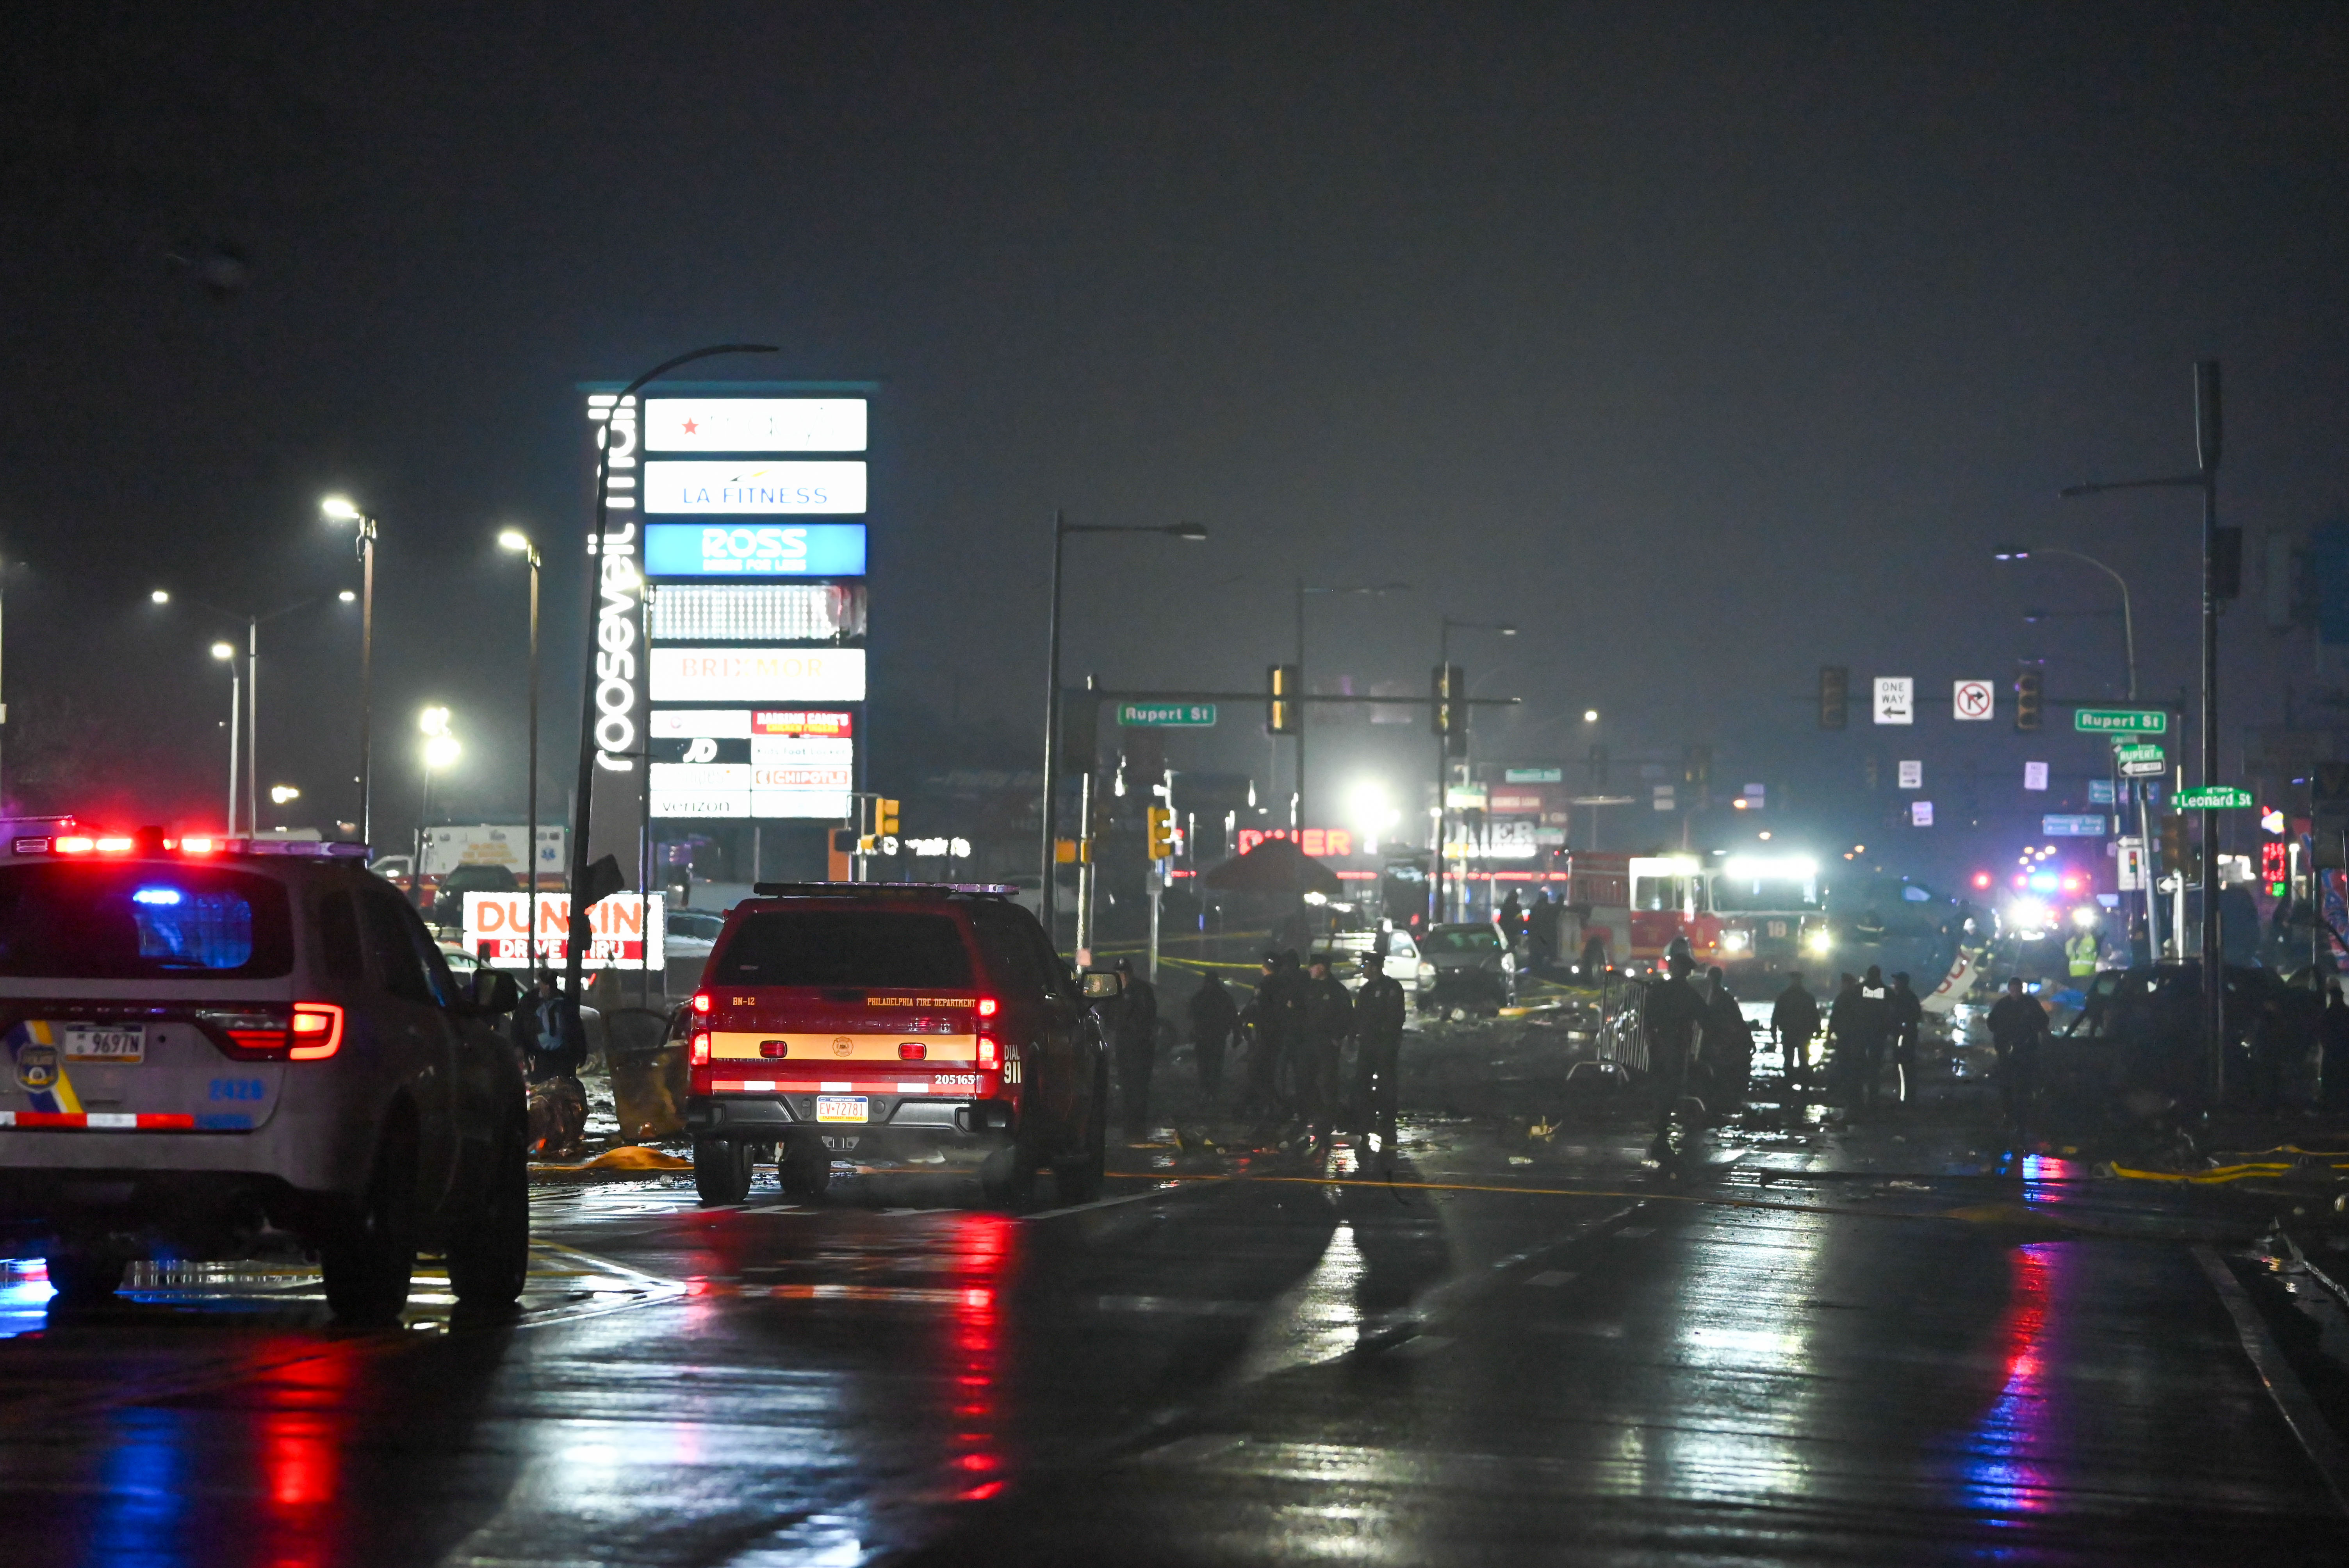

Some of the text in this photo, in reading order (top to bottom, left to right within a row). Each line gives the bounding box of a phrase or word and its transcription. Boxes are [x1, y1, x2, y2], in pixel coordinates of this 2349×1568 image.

[683, 488, 827, 503] LA FITNESS
[702, 528, 807, 558] ROSS
[683, 658, 822, 677] BRIXMOR
[1882, 682, 1904, 691] ONE
[1882, 695, 1904, 703] WAY
[1126, 707, 1208, 722] Rupert St
[2082, 714, 2159, 728] Rupert St
[683, 738, 717, 763] JD
[775, 772, 847, 783] CHIPOTLE
[663, 800, 729, 813] verizon
[2181, 793, 2233, 807] Leonard
[2239, 793, 2252, 807] St
[499, 938, 561, 958] DRVE
[733, 997, 756, 1006] BN-12
[867, 997, 976, 1008] PHILADELPHIA FIRE DEPARTMENT
[1004, 1044, 1020, 1060] DIAL
[1004, 1061, 1021, 1084] 911
